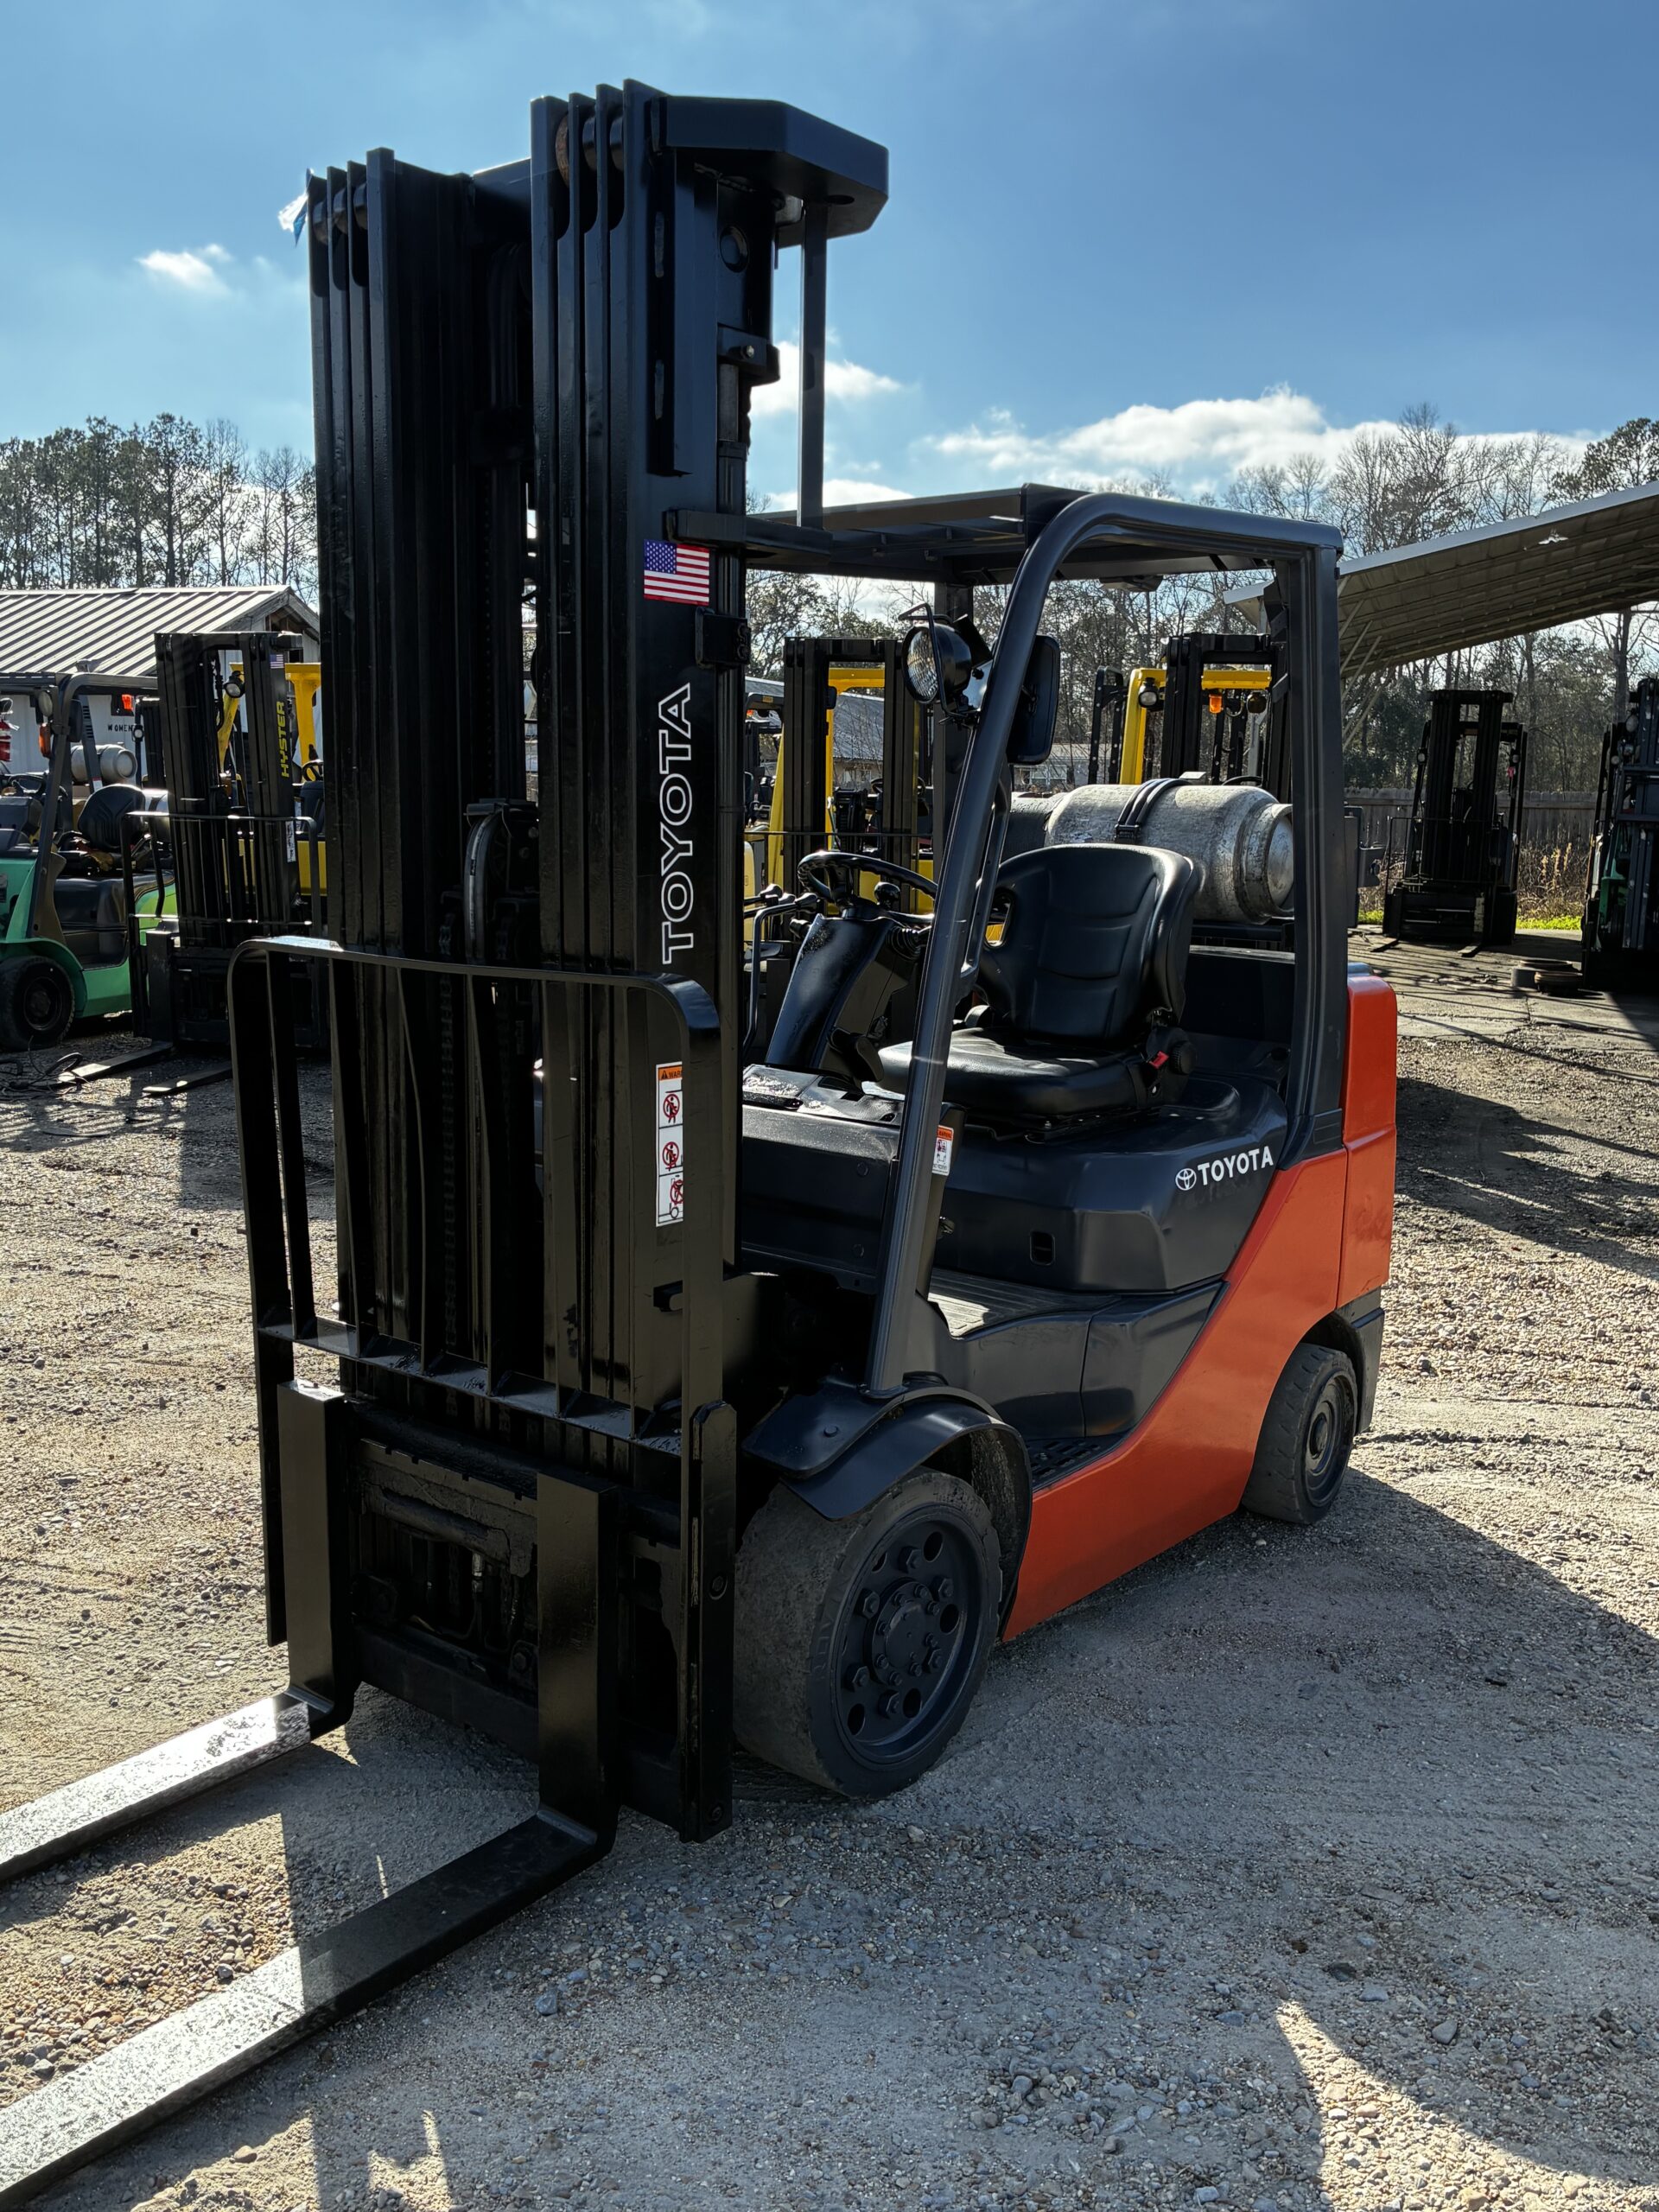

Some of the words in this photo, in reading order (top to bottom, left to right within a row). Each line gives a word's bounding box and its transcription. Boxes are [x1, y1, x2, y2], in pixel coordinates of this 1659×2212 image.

[276, 701, 290, 778] HYSTER
[658, 682, 694, 965] TOYOTA
[1197, 1146, 1274, 1185] TOYOTA
